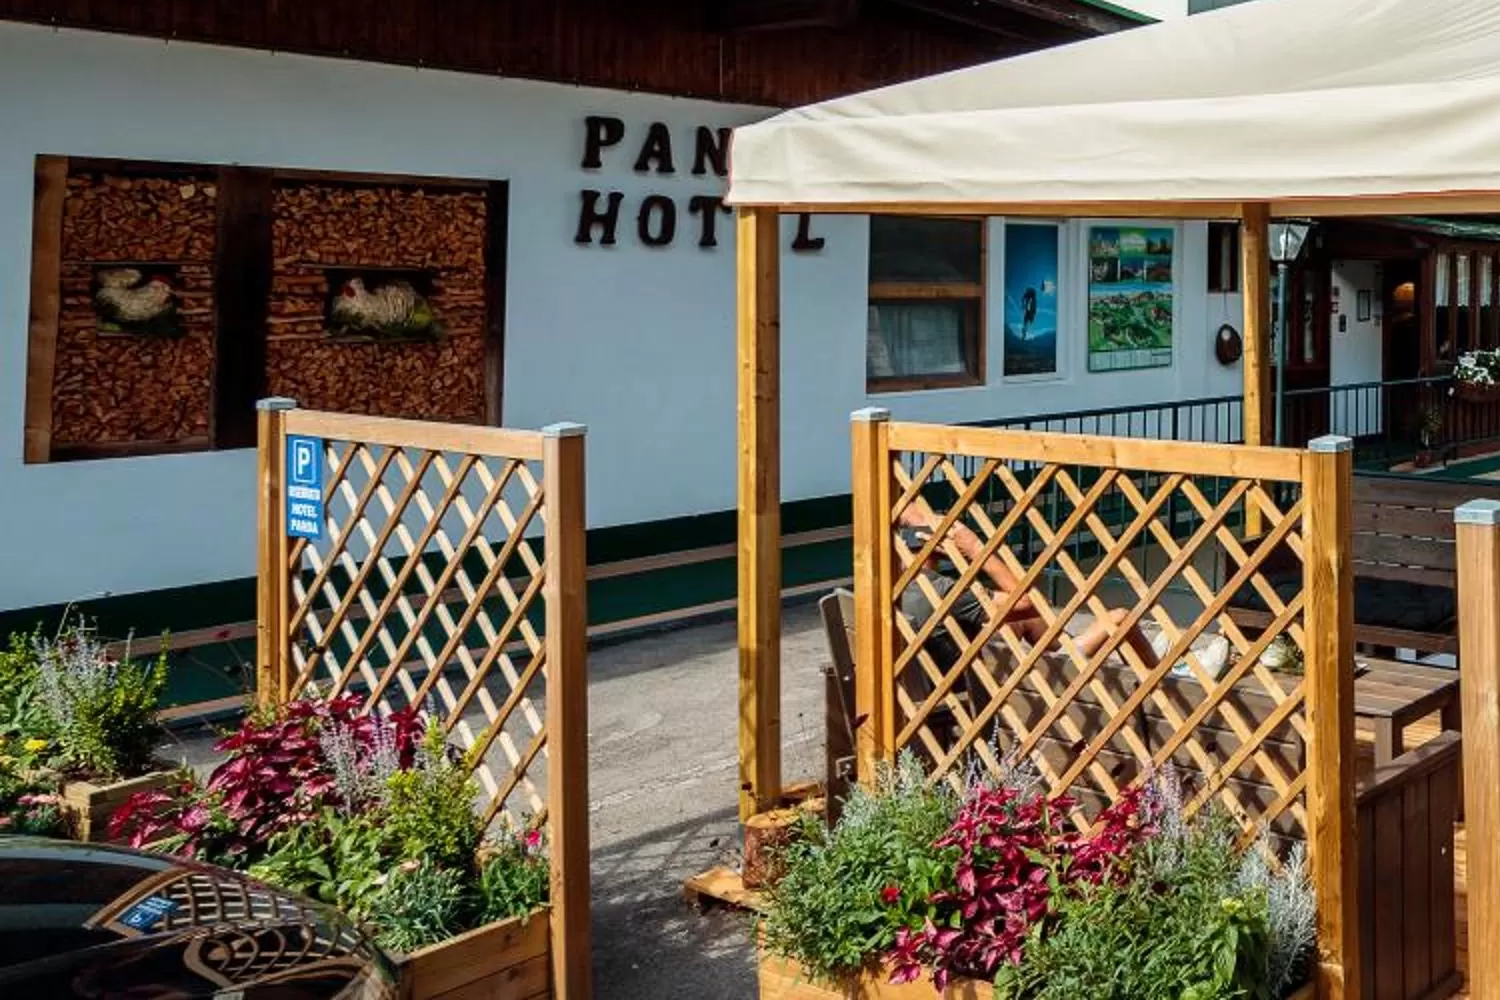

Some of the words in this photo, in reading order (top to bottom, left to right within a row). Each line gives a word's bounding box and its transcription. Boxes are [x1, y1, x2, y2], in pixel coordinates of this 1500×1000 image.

[580, 115, 734, 176] PAN
[574, 189, 826, 250] HOTL
[298, 447, 311, 475] P
[291, 503, 318, 518] HOTEL
